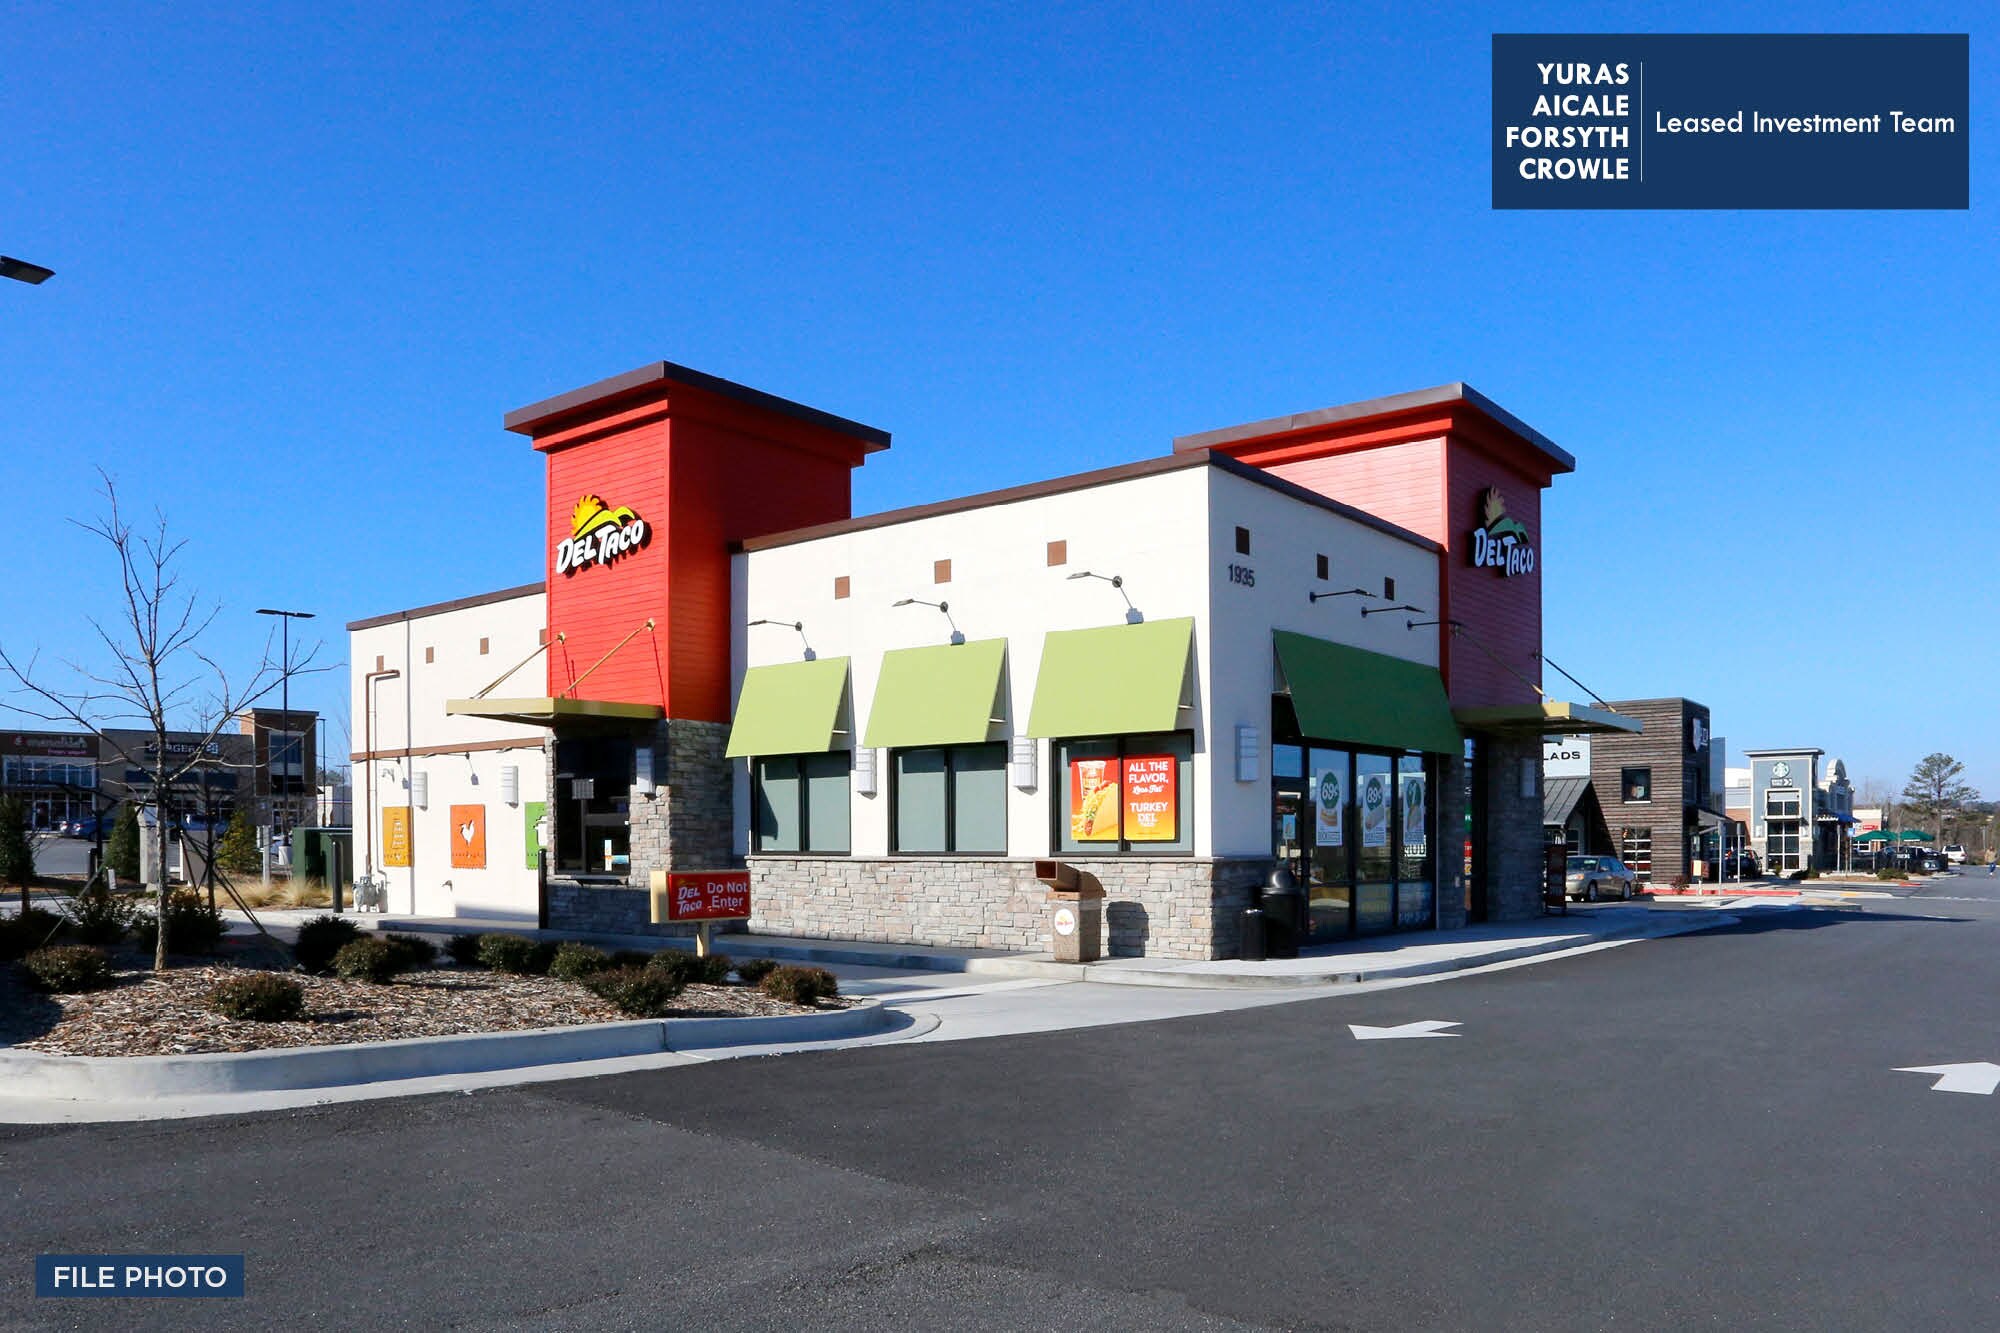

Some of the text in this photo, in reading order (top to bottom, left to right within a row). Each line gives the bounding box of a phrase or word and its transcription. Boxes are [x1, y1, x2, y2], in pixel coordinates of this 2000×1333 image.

[555, 519, 645, 575] DEL TACO
[1473, 527, 1534, 577] DEL TACO
[1228, 564, 1255, 588] 1935
[1128, 761, 1168, 772] ALL THE
[1129, 801, 1168, 813] TURKEY
[678, 886, 700, 900] DEL
[706, 882, 747, 894] Do Not
[677, 900, 703, 915] TACO
[711, 895, 744, 908] Enter
